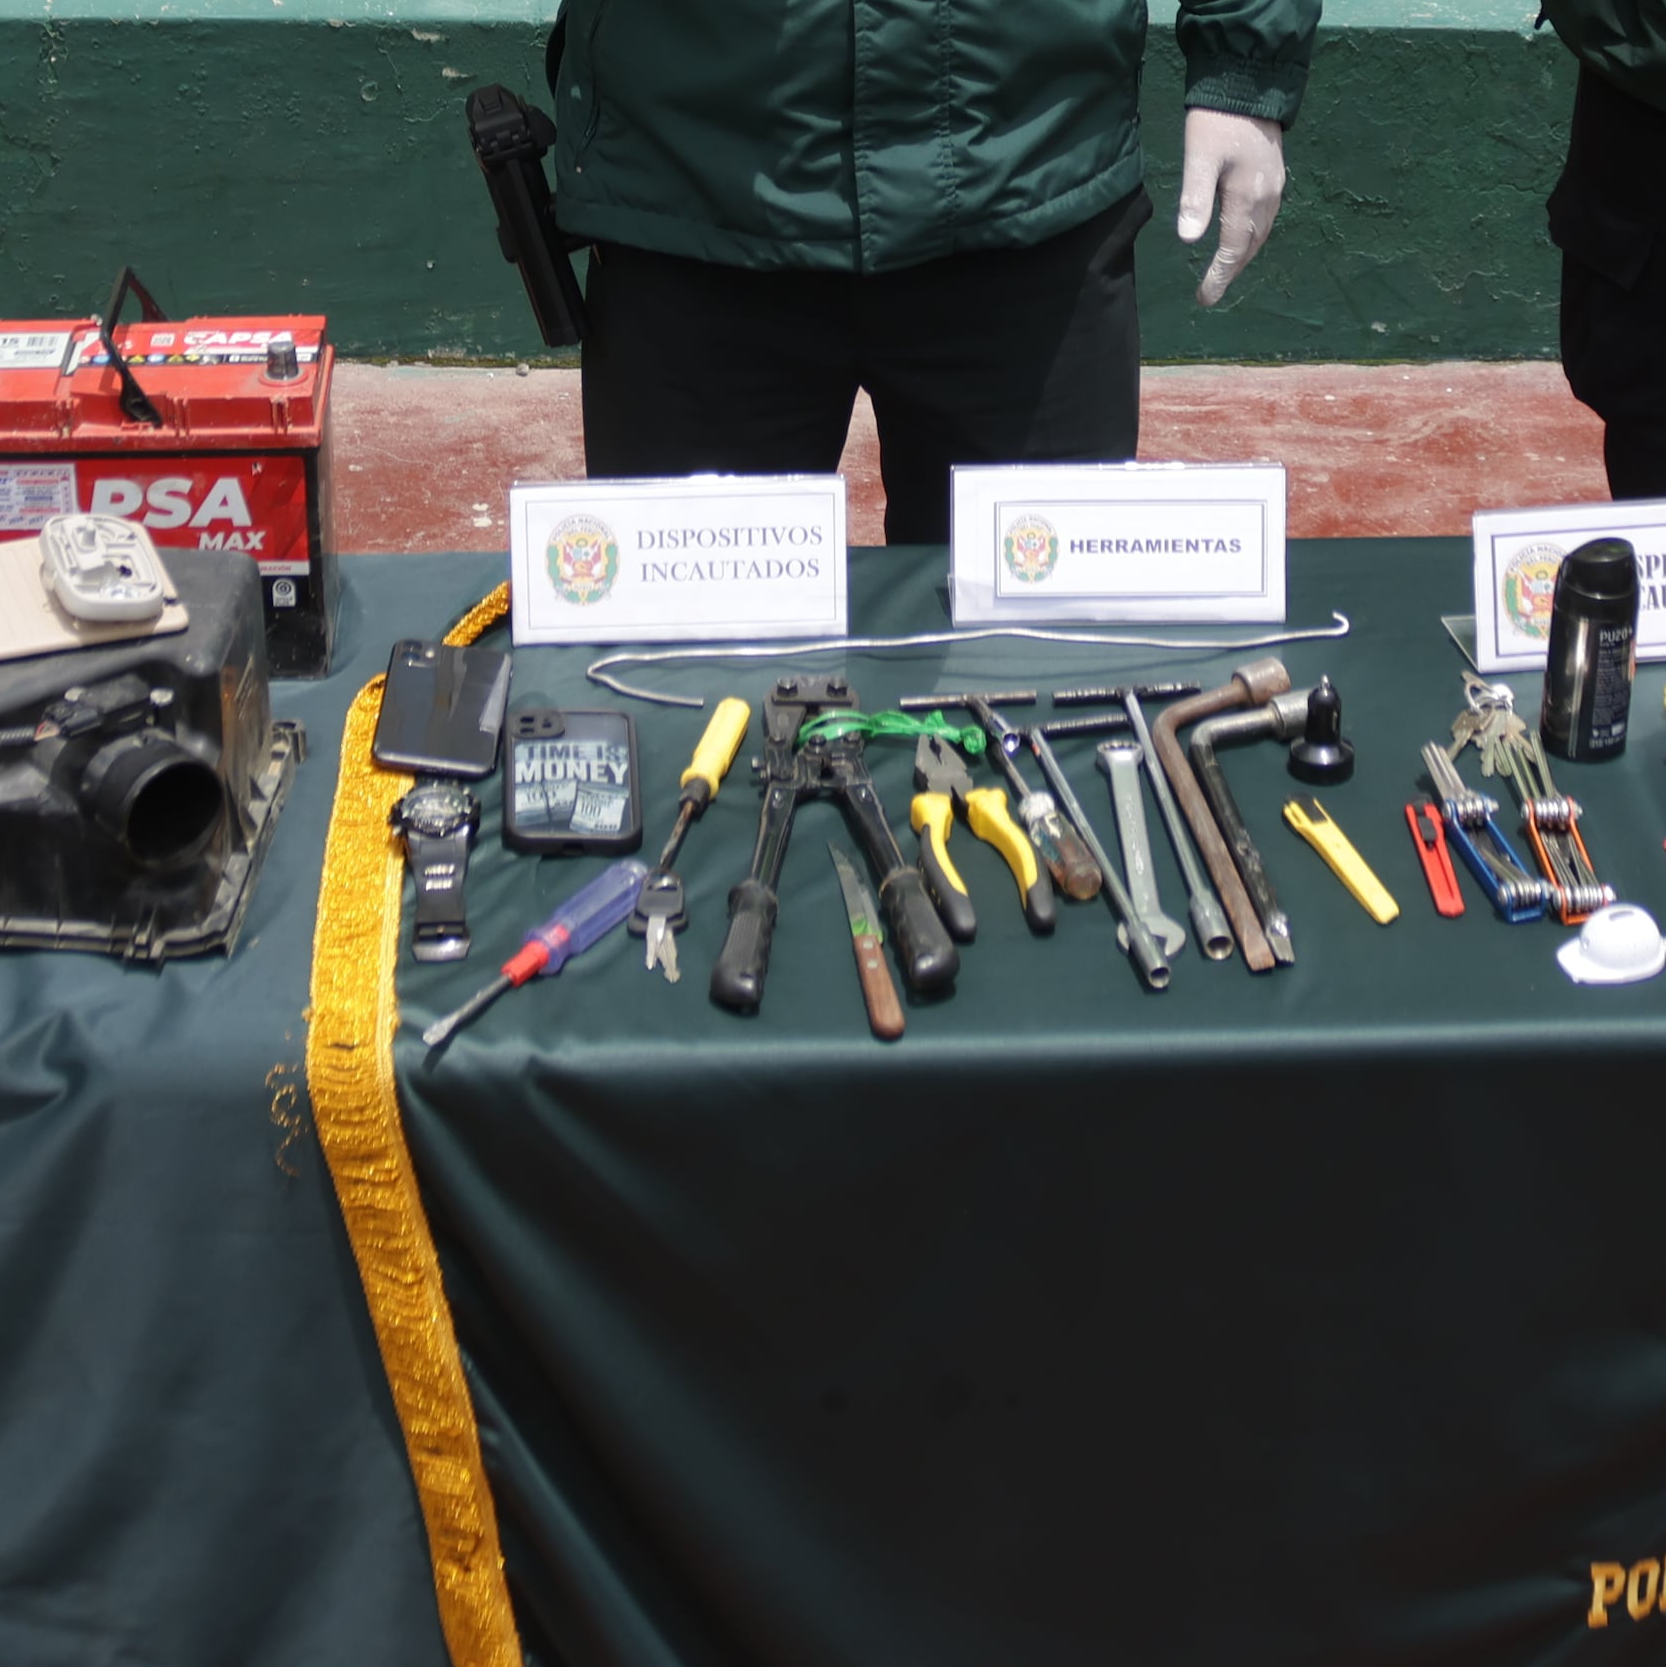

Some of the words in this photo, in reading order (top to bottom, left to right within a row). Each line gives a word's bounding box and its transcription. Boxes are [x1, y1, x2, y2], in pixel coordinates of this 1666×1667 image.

[90, 476, 253, 529] PSA
[198, 531, 266, 551] MAX
[637, 525, 823, 550] DISPOSITIVOS
[1069, 537, 1243, 556] HERRAMIENTAS
[640, 557, 821, 583] INCAUTADOS
[524, 744, 580, 760] TIME
[515, 760, 628, 785] MONEY
